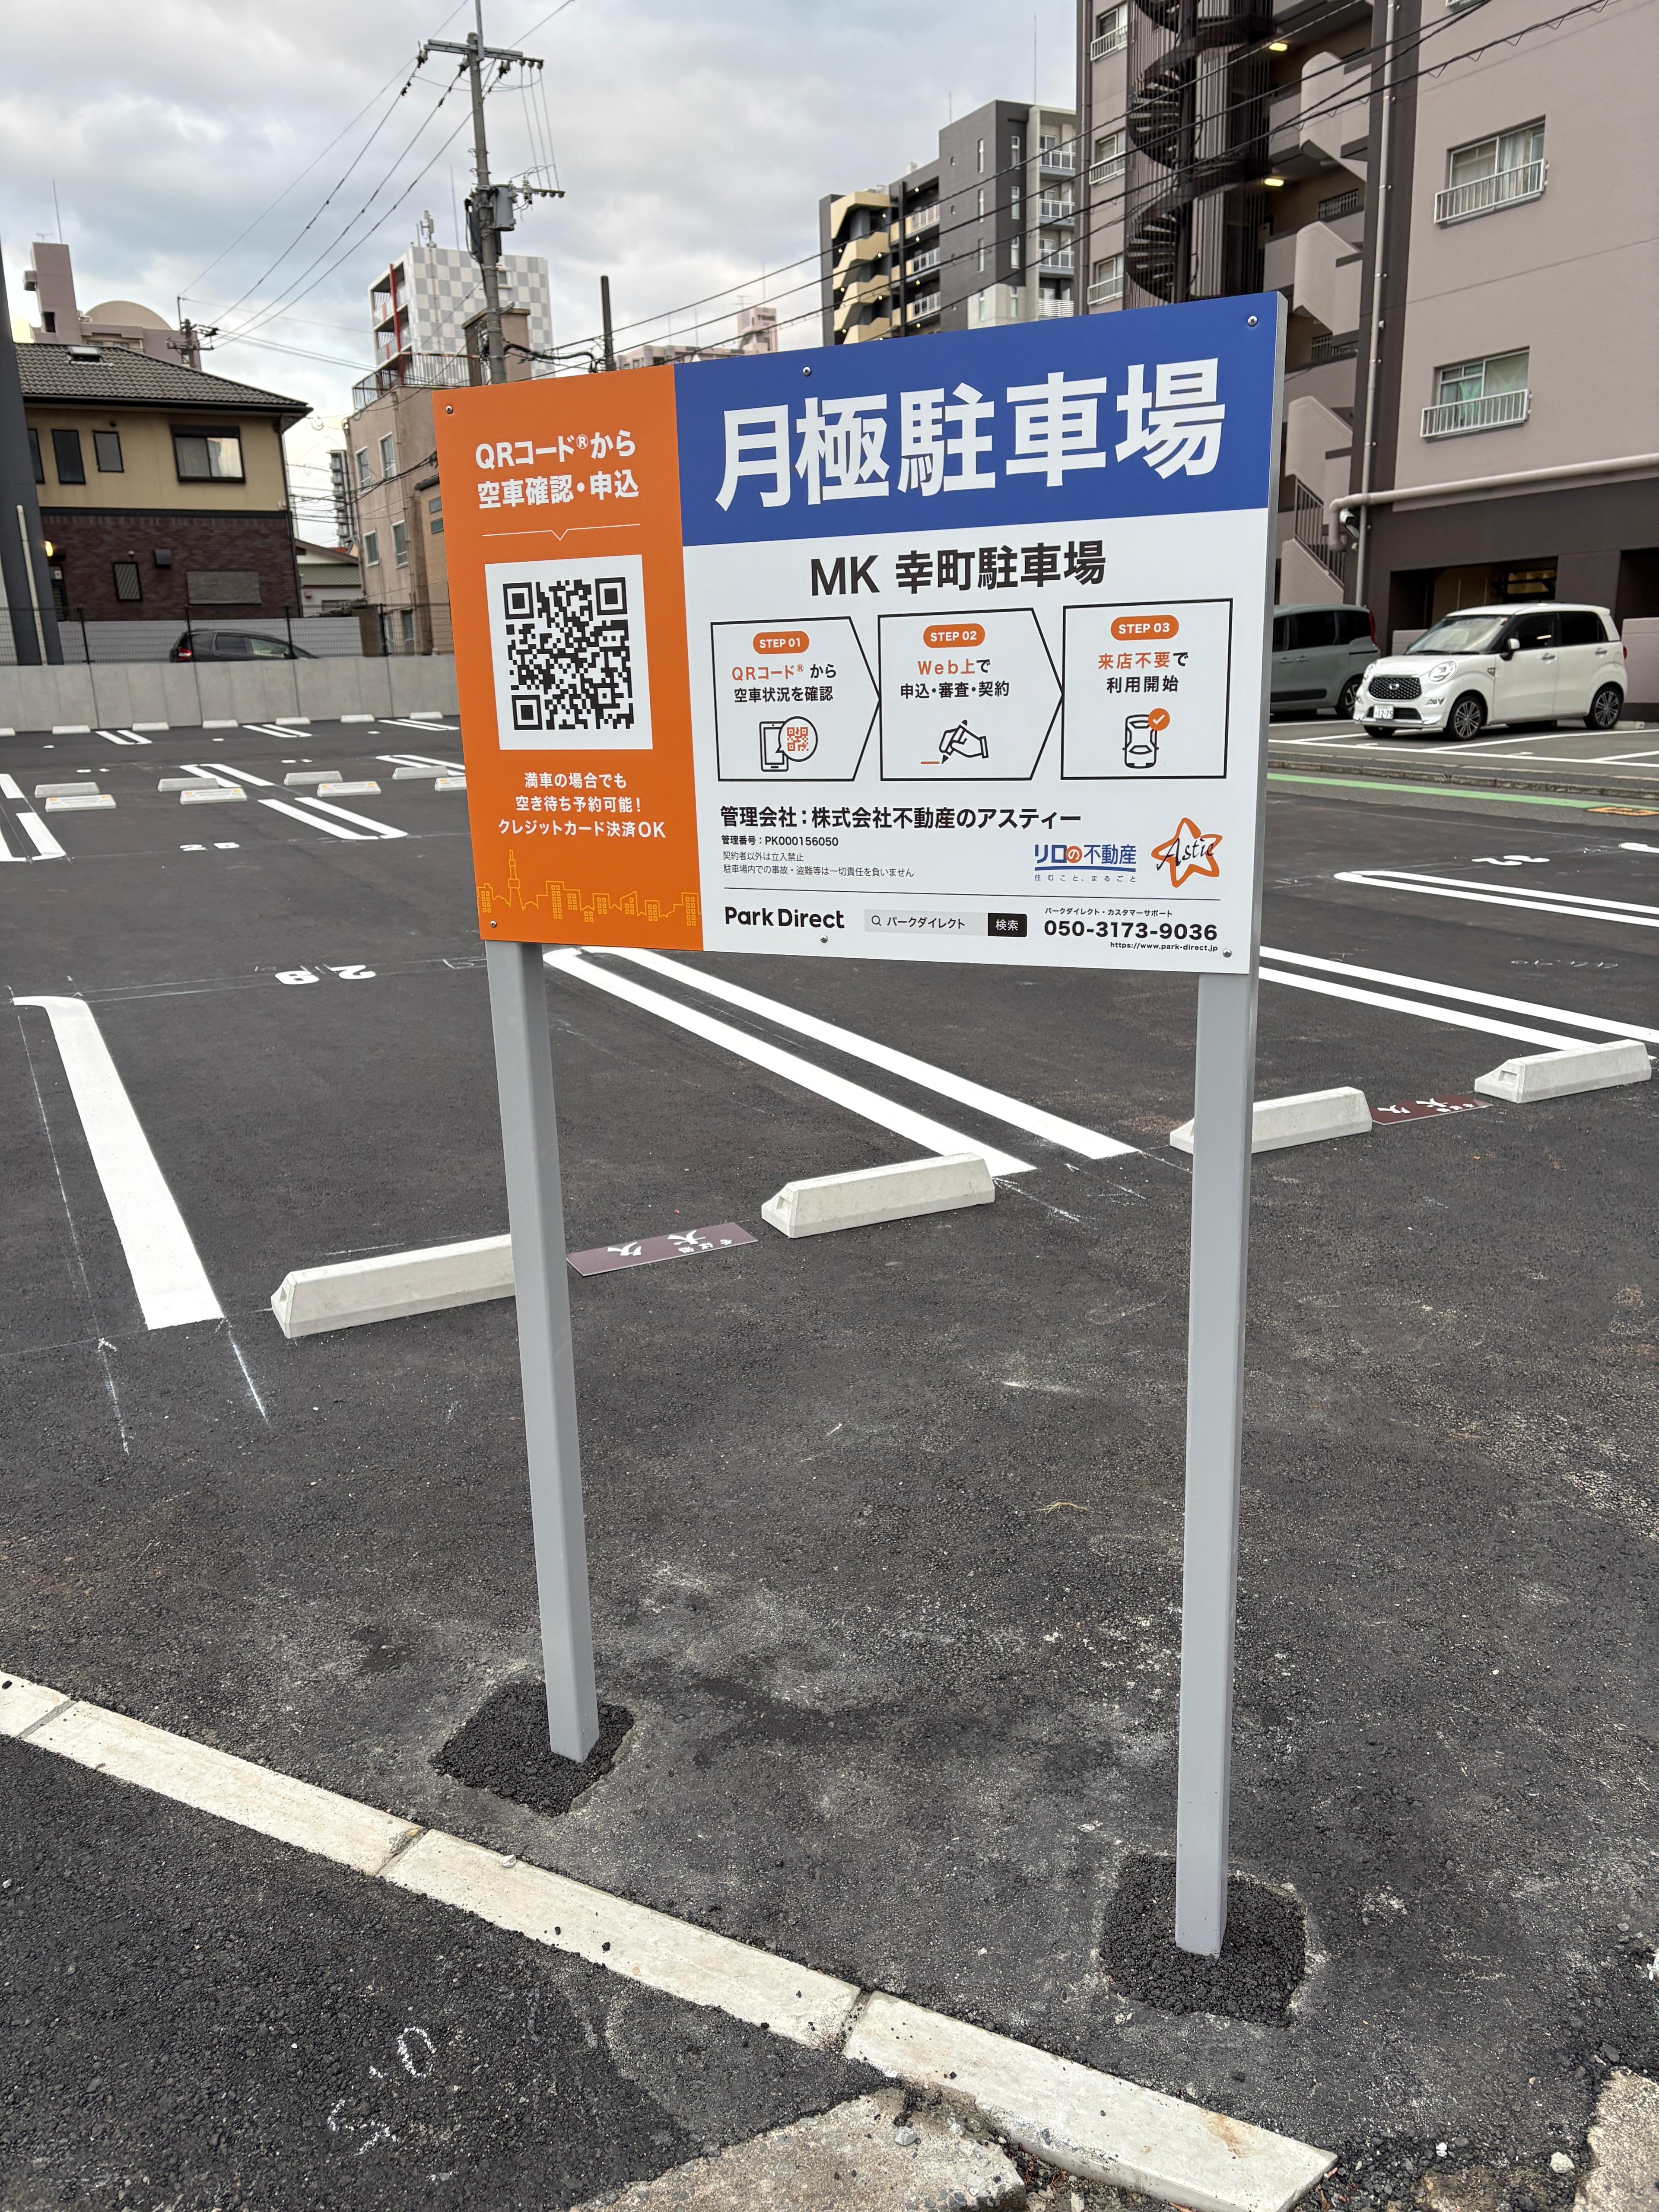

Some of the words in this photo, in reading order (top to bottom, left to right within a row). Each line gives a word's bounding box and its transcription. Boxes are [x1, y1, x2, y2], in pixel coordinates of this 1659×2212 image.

[715, 357, 1225, 512] 月極駐車場
[478, 469, 639, 509] 空車確認・申込
[810, 554, 880, 597] MK
[896, 540, 1106, 594] 幸町駐車場
[930, 632, 960, 642] STEP
[962, 631, 977, 640] 02
[1119, 623, 1150, 634] STEP
[1153, 622, 1170, 632] 03
[759, 639, 786, 648] STEP
[788, 638, 801, 648] 01
[917, 658, 991, 675] Web上で
[1098, 652, 1189, 670] 来店不要で
[900, 680, 1010, 699] 申込・審査・契約
[1106, 675, 1179, 693] 利用開始
[734, 686, 833, 703] 空車状況を確認
[524, 772, 627, 789] 満車の場合でも
[515, 795, 641, 813] 空き待ち予約可能！
[498, 820, 666, 838] クレジットカード決済OK
[723, 851, 804, 862] 契約者以外は立入禁止
[1035, 844, 1137, 864] リロの不動産
[1156, 836, 1215, 871] Astie
[887, 916, 965, 929] パークダイレクト
[995, 919, 1019, 931] 検索
[1044, 920, 1218, 941] 050-3173-9036
[1110, 942, 1218, 952] https://www.park-direct.jp
[275, 965, 376, 985] 29
